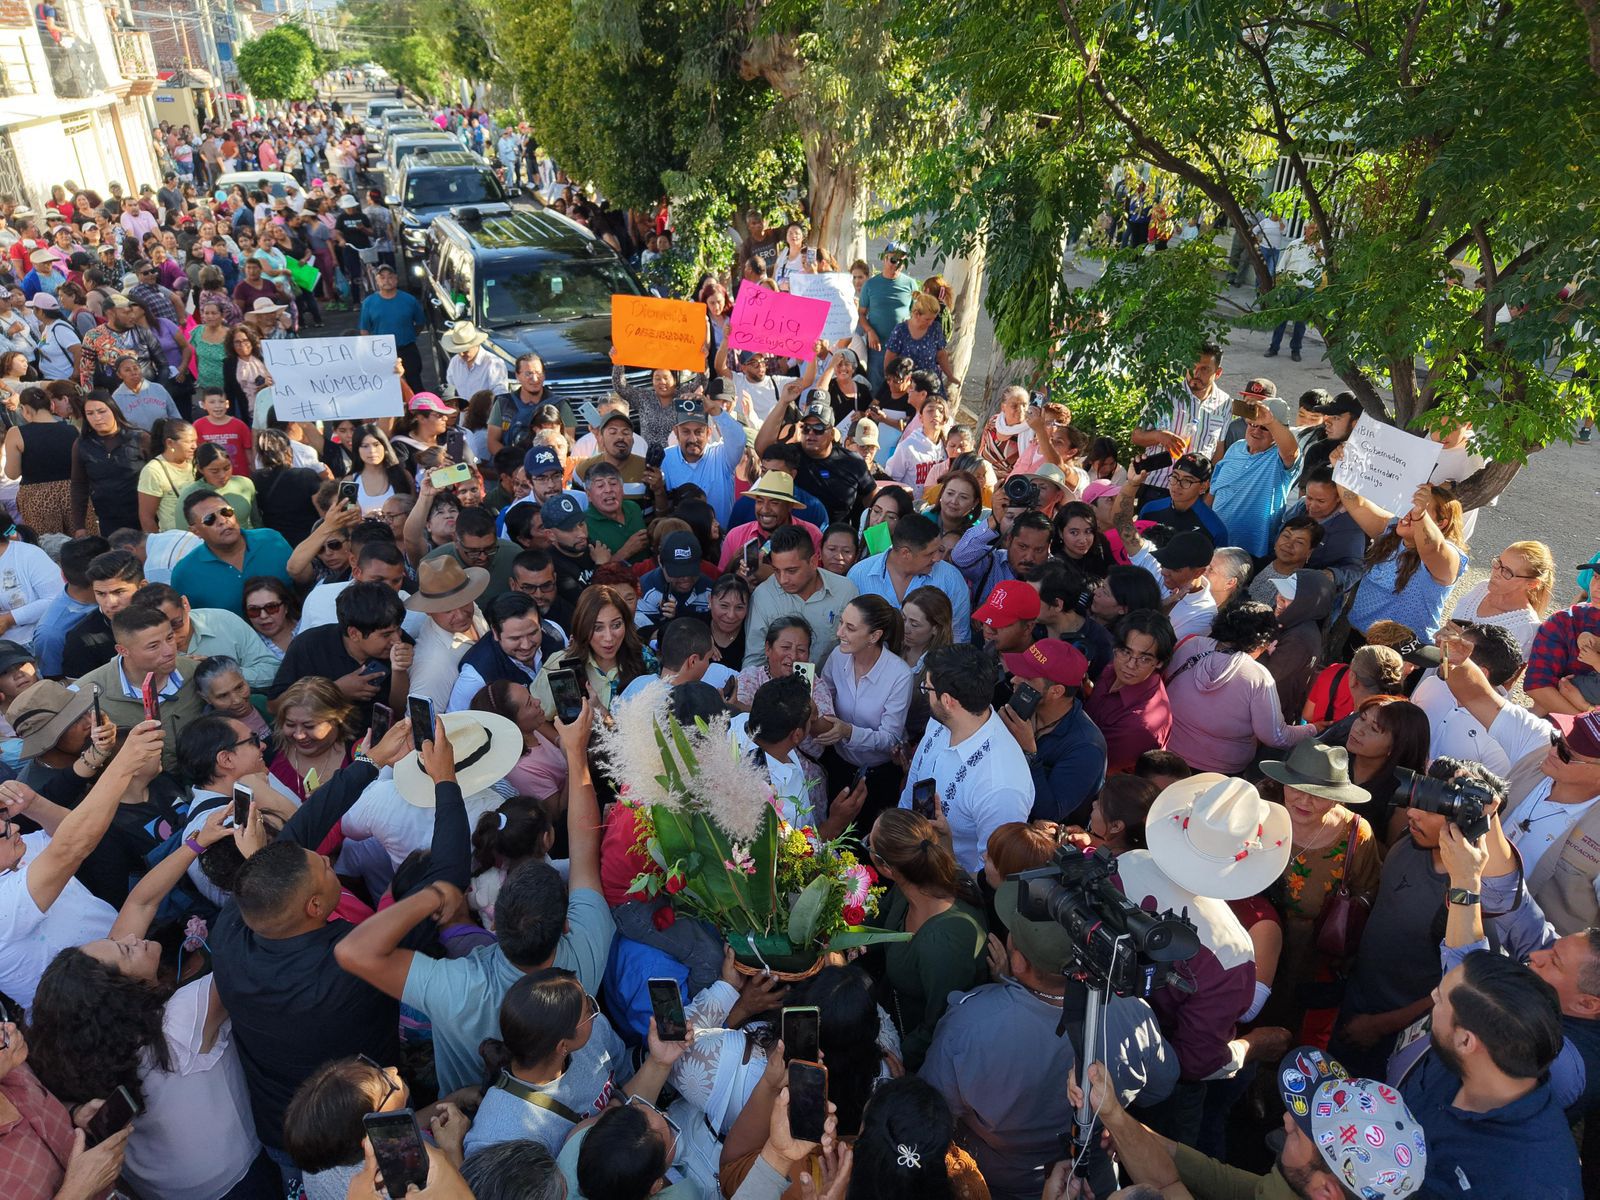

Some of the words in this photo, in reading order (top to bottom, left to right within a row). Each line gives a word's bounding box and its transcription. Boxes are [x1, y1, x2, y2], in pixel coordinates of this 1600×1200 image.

[755, 249, 776, 259] ERO
[739, 296, 800, 336] Libia
[265, 342, 353, 367] LIBIA
[310, 374, 383, 395] NÚMERO
[291, 400, 320, 419] #
